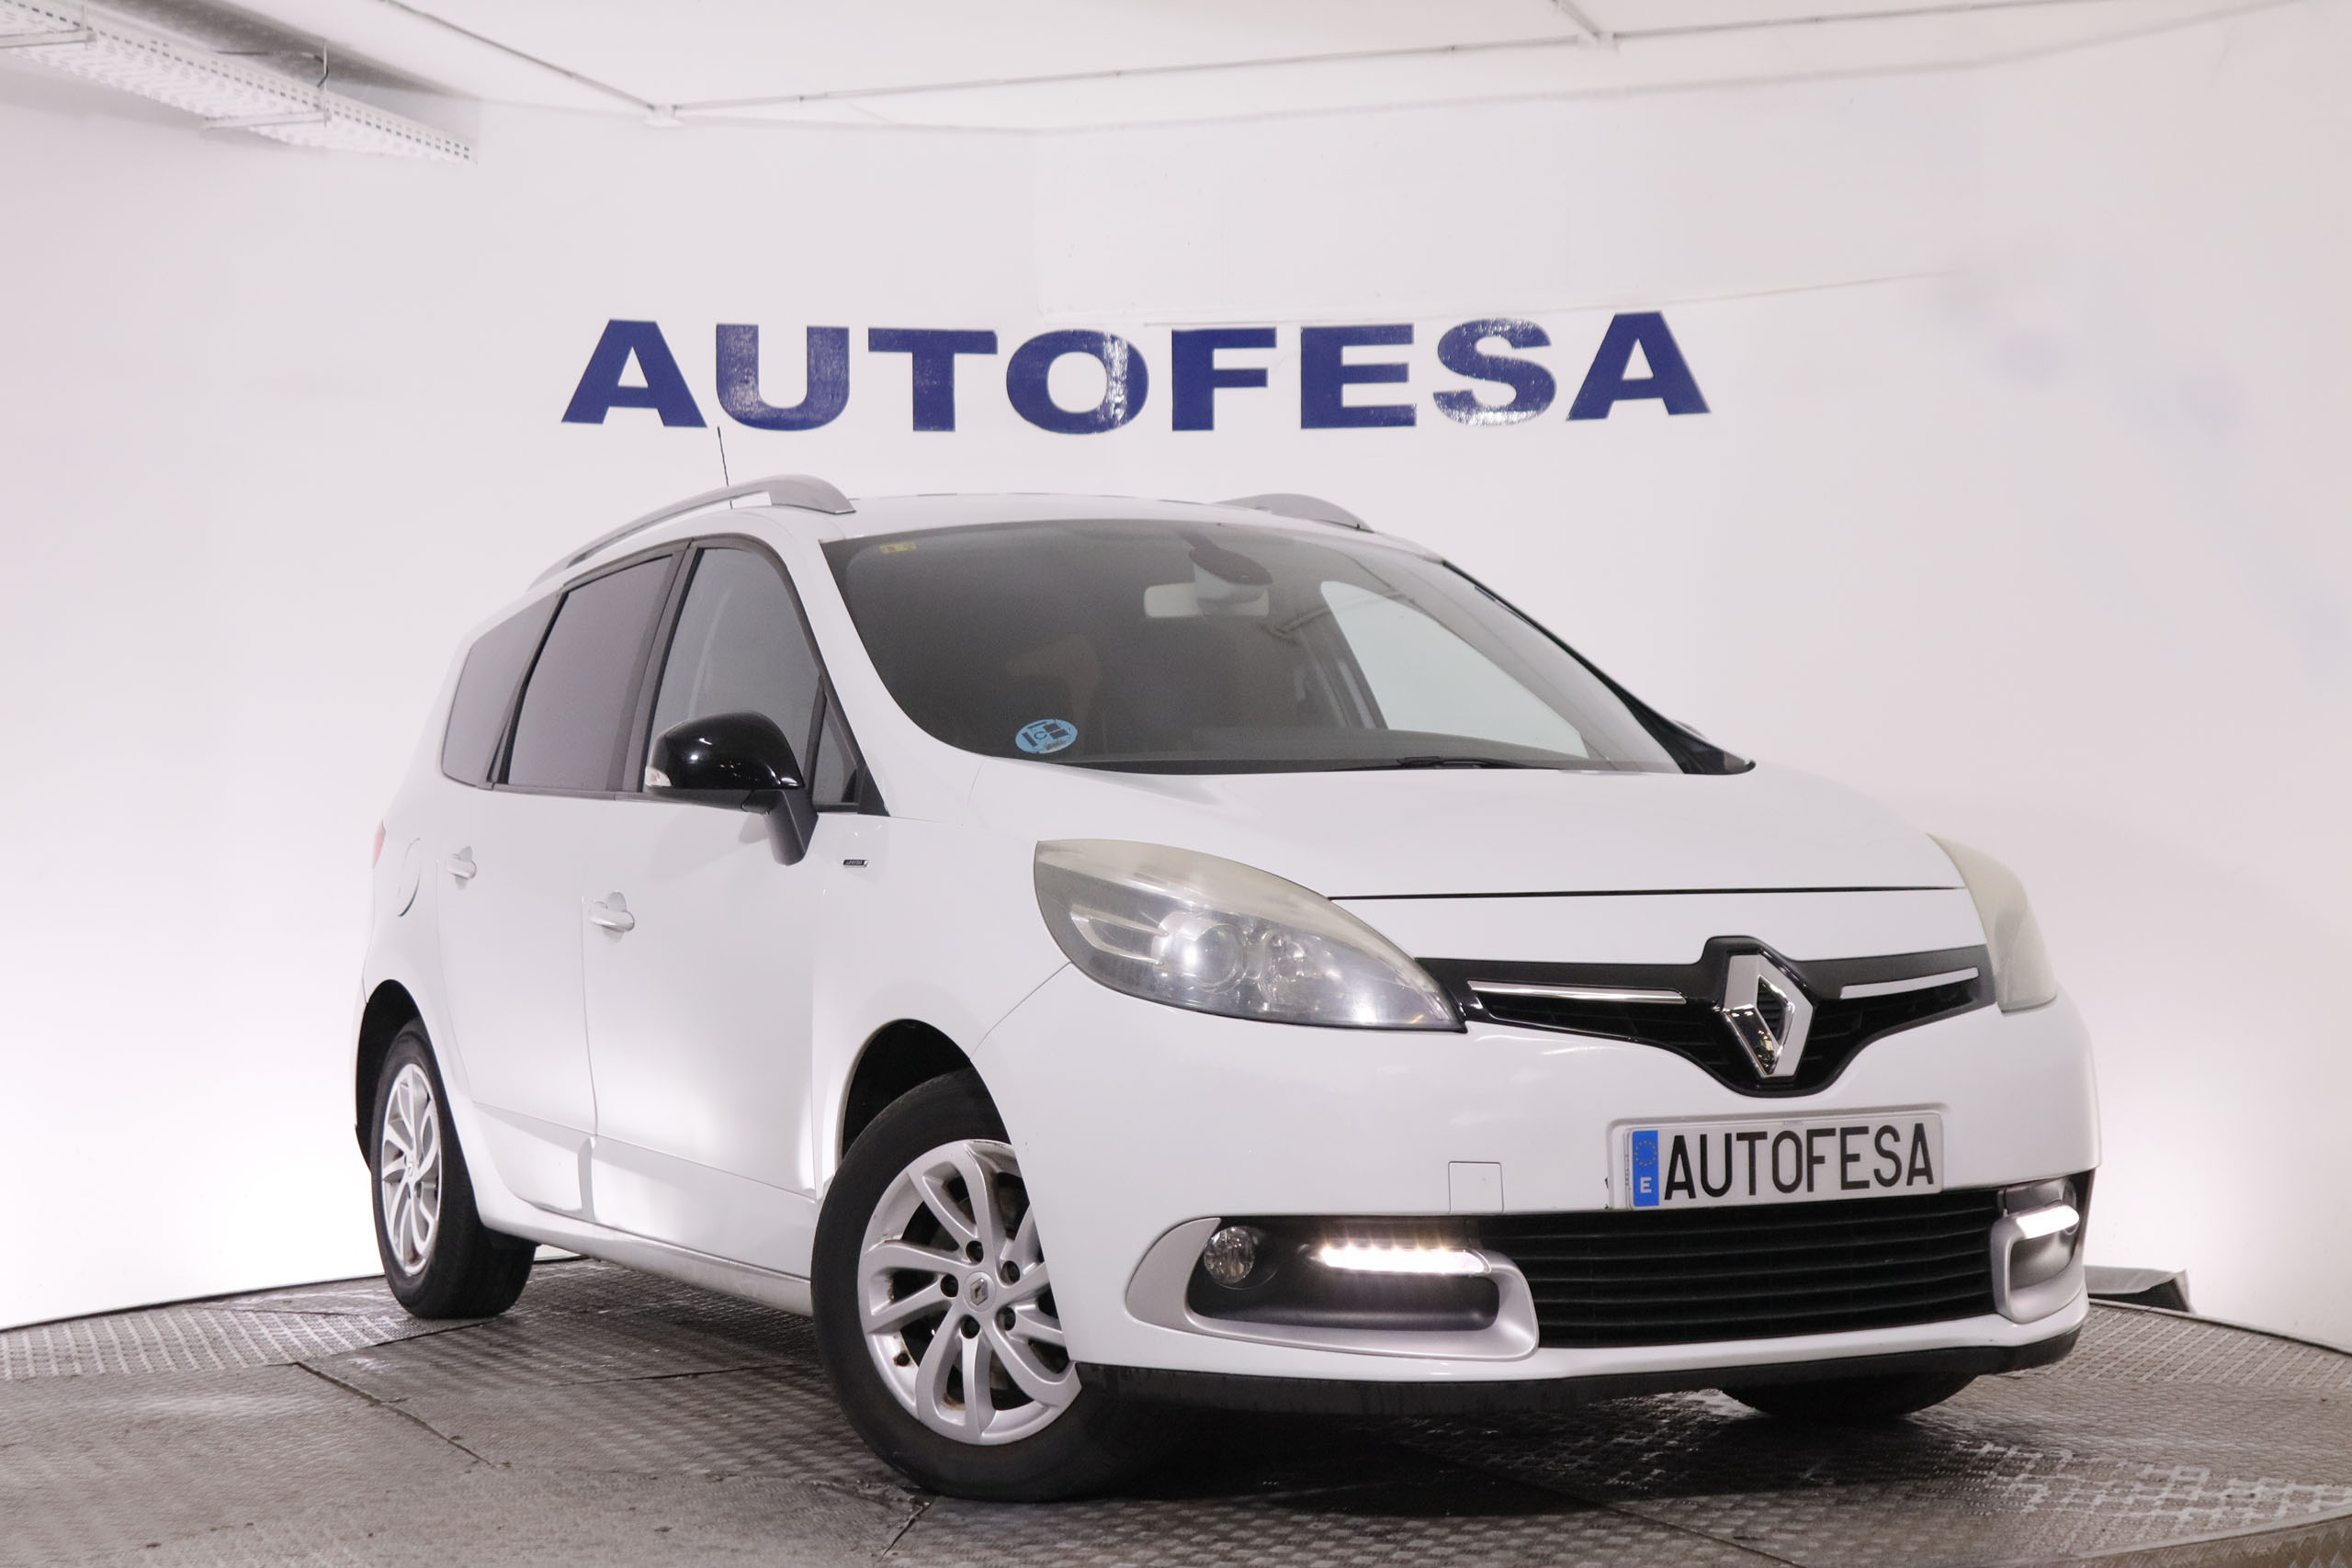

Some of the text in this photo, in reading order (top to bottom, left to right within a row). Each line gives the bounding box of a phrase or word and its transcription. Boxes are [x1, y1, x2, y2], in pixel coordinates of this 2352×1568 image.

[562, 312, 1709, 434] AUTOFESA
[1640, 1177, 1652, 1193] E
[1664, 1122, 1935, 1201] AUTOFESA
